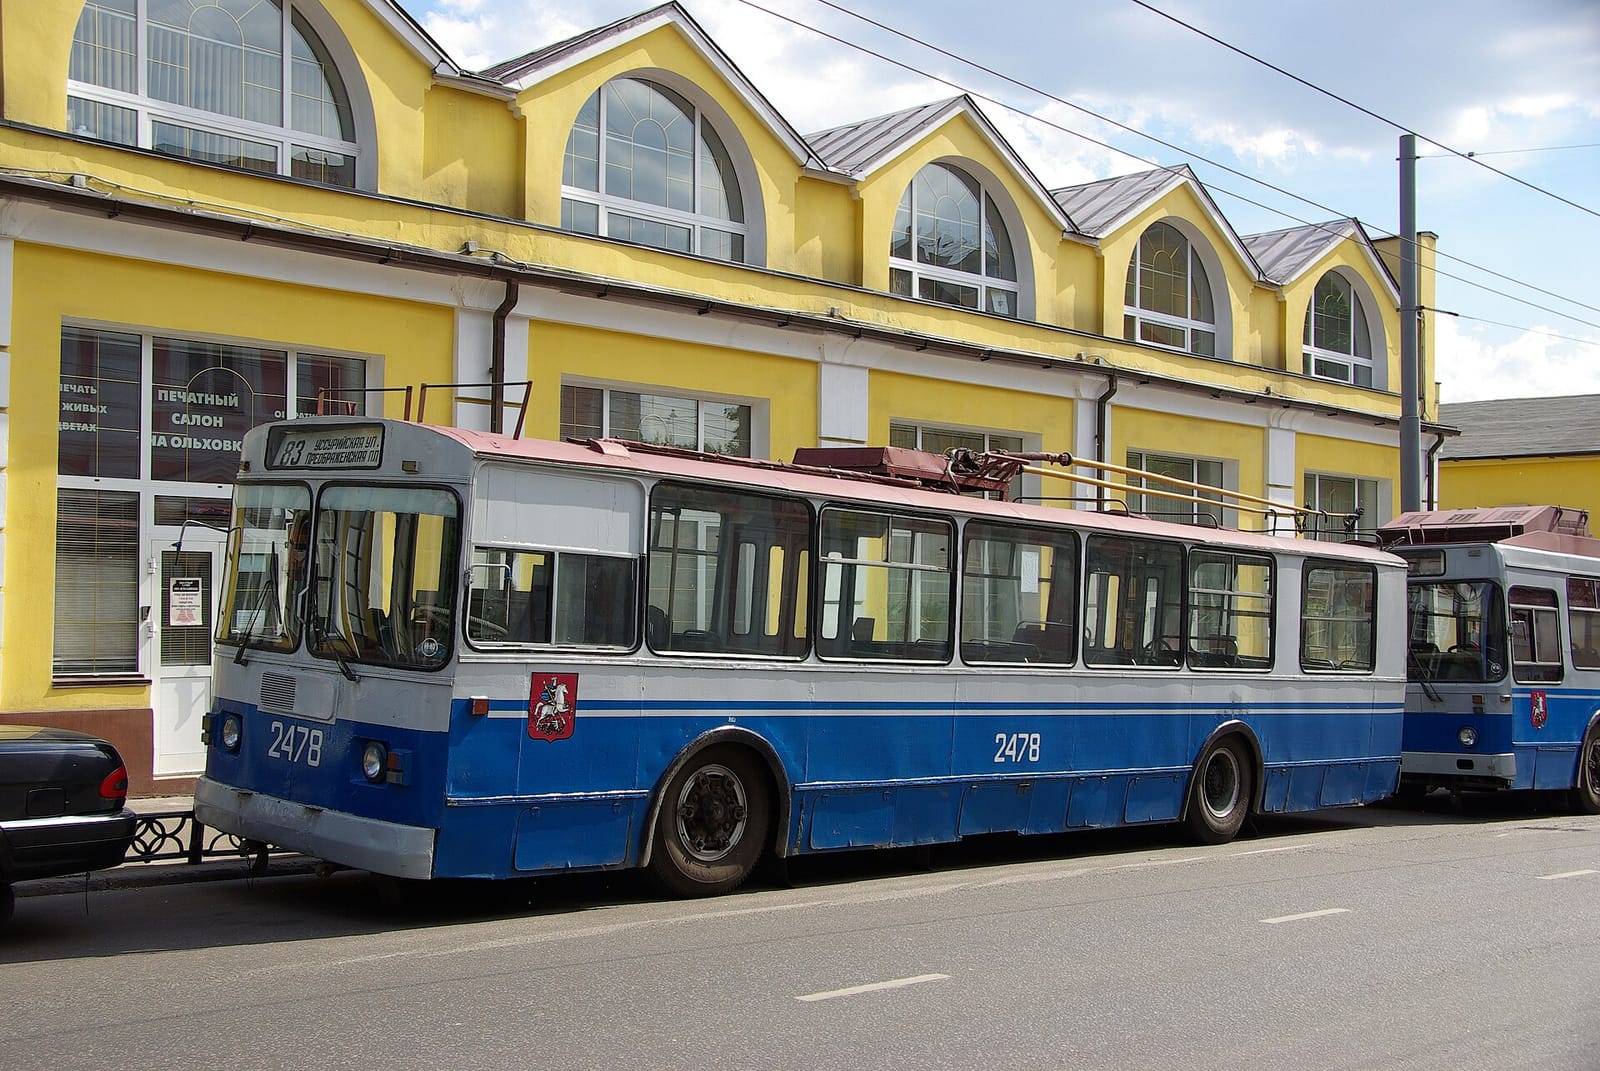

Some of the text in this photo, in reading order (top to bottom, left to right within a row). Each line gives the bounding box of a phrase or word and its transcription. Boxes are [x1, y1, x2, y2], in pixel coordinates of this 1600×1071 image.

[158, 389, 239, 408] ПЕЧАТНЫЙ
[62, 402, 108, 414] ЖИВЫХ
[171, 412, 224, 428] САЛОН
[170, 436, 242, 451] ОЛЬХОВК
[268, 721, 324, 767] 2478
[994, 733, 1041, 762] 2478
